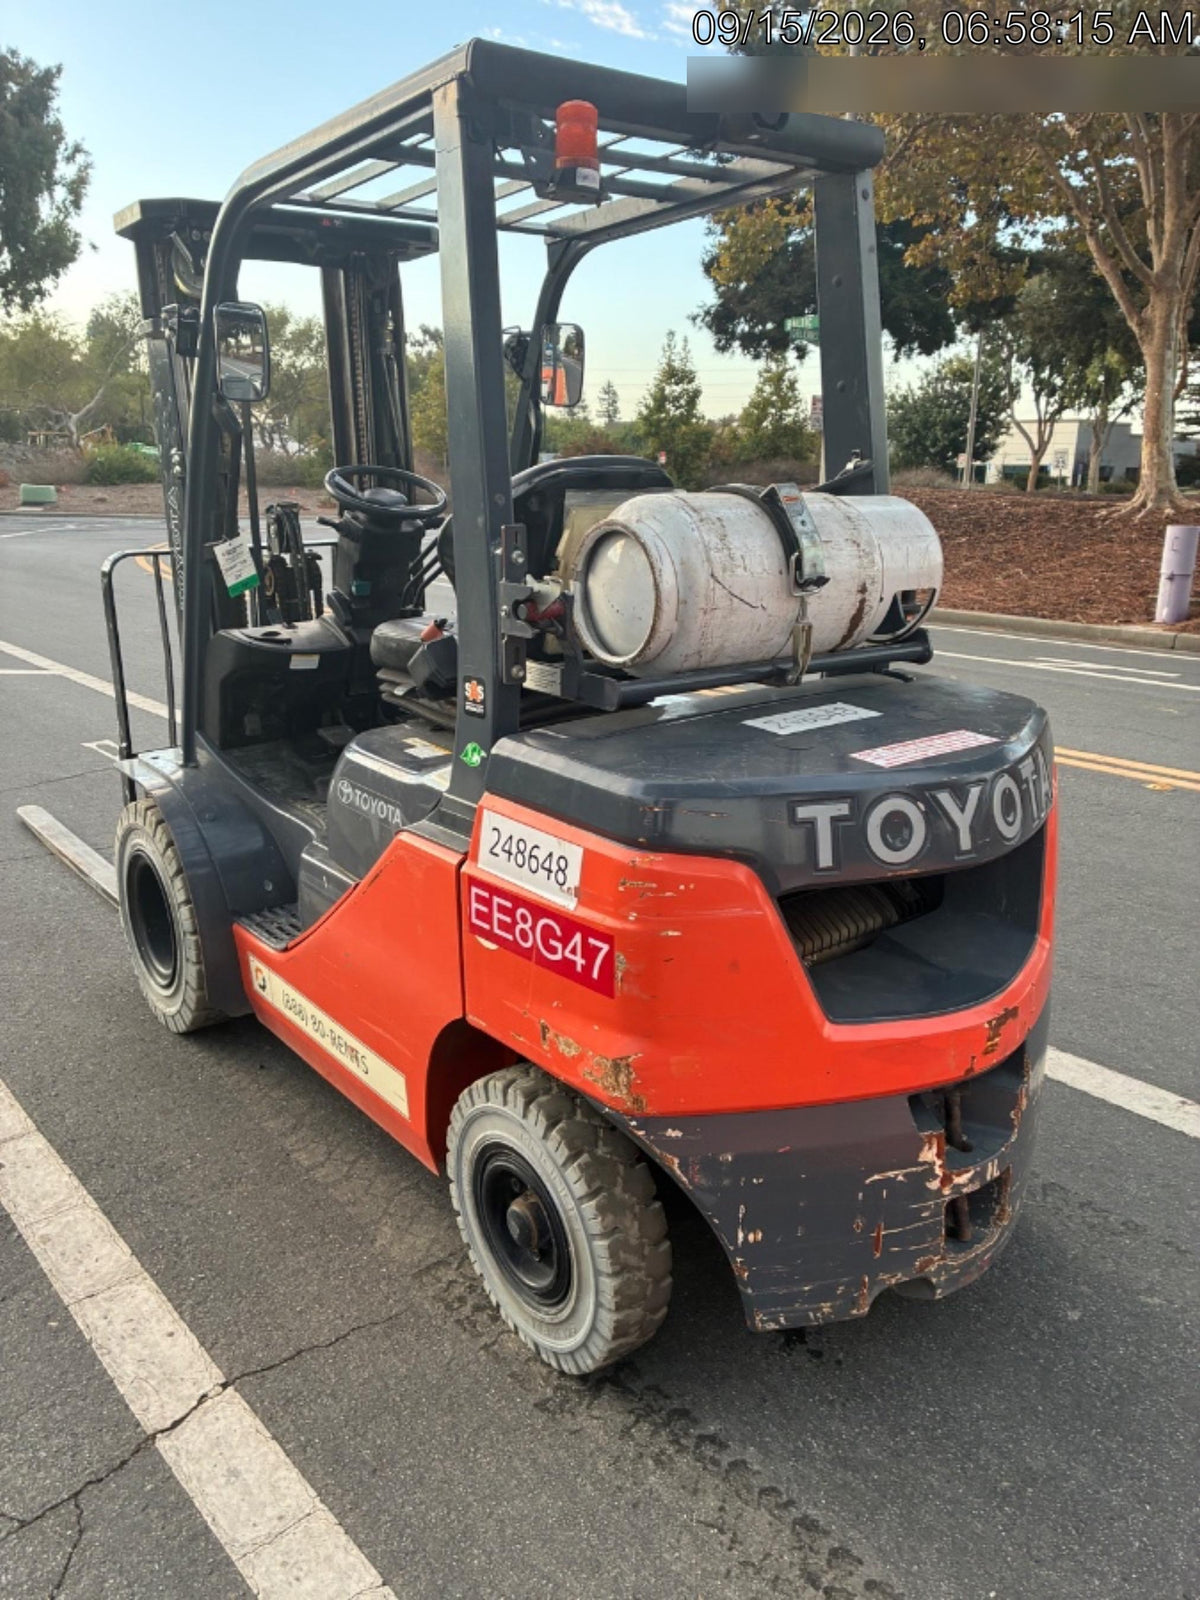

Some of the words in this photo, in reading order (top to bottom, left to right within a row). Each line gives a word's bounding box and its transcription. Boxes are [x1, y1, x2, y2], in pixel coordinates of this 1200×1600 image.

[354, 789, 403, 828] TOYOTA
[796, 746, 1052, 868] TOYOTA
[489, 827, 569, 887] 248648
[470, 885, 610, 980] EE8G47
